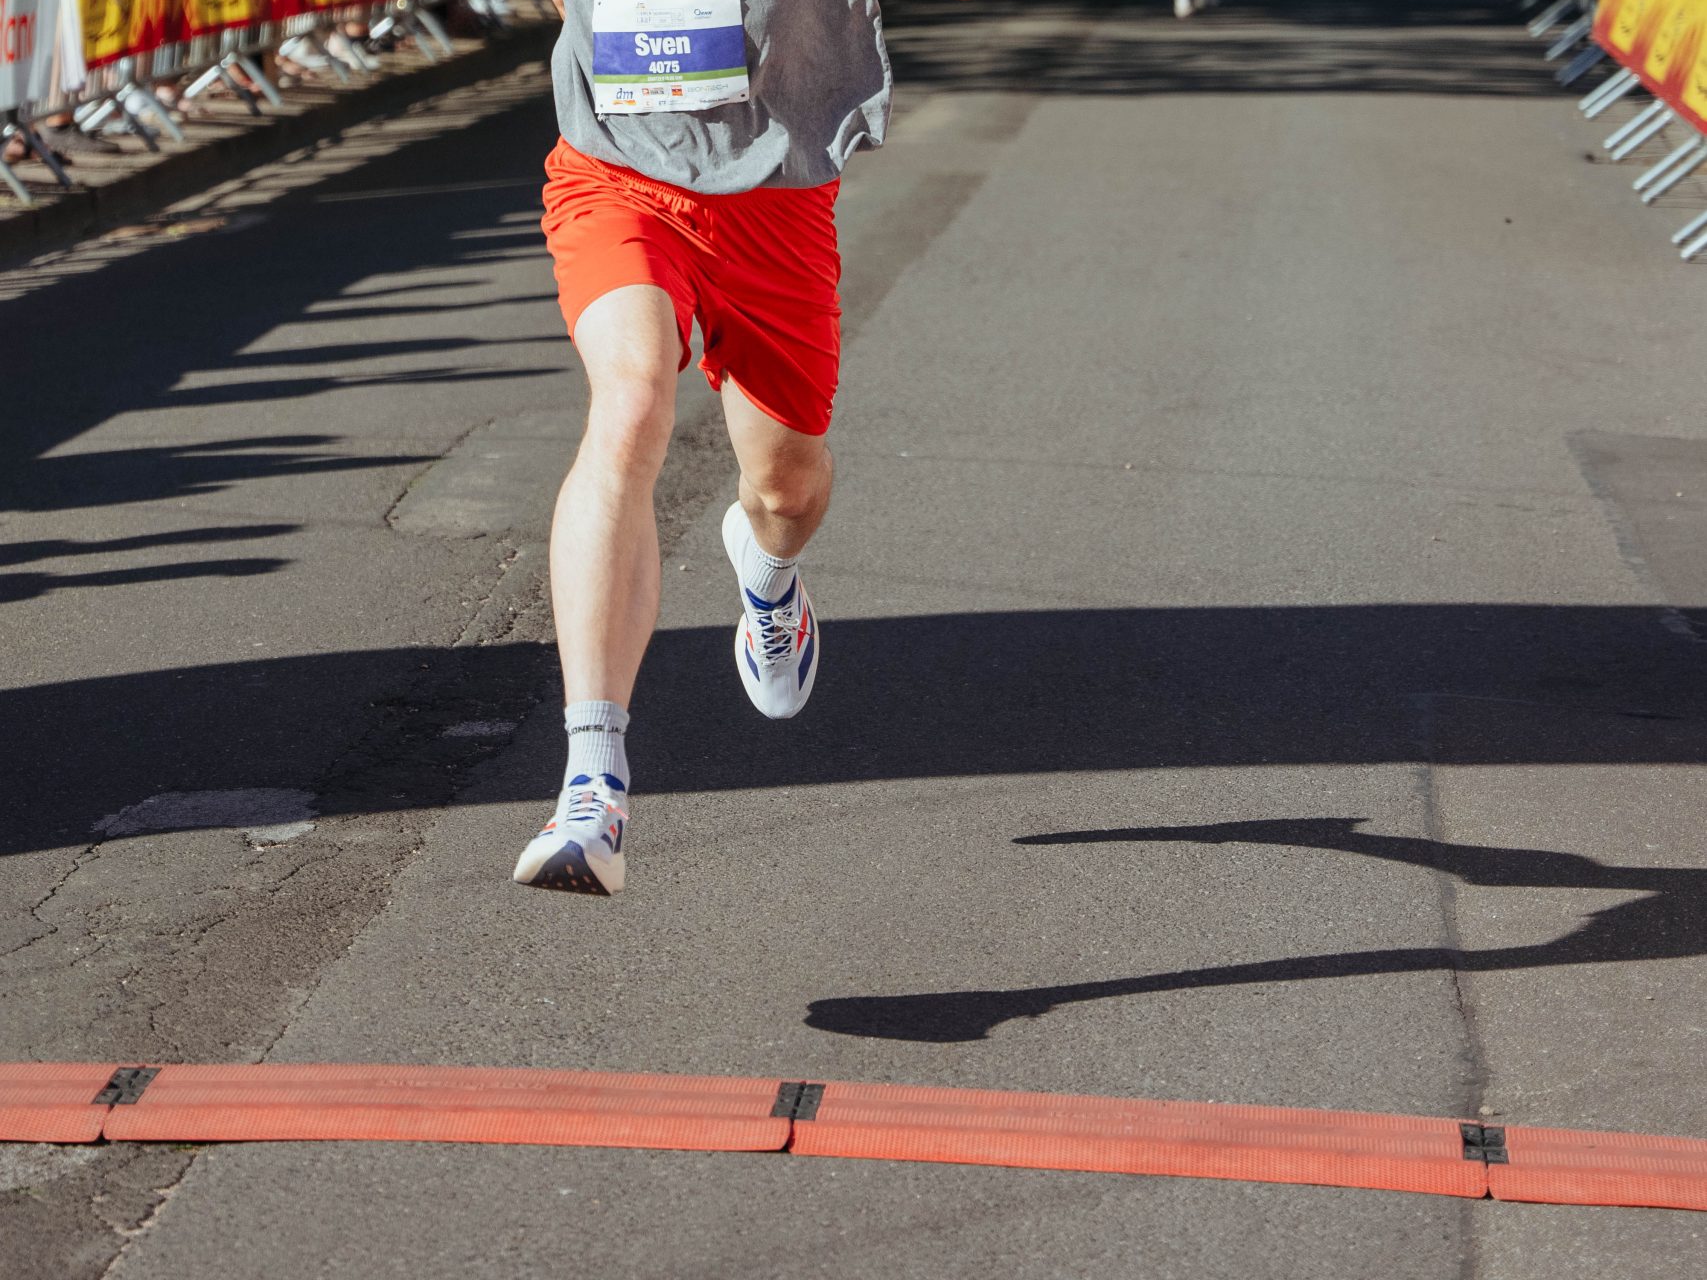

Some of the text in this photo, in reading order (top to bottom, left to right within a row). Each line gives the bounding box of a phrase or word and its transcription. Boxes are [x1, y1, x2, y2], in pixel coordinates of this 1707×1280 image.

[634, 32, 691, 56] Sven
[649, 60, 680, 74] 4075
[616, 87, 634, 100] dm
